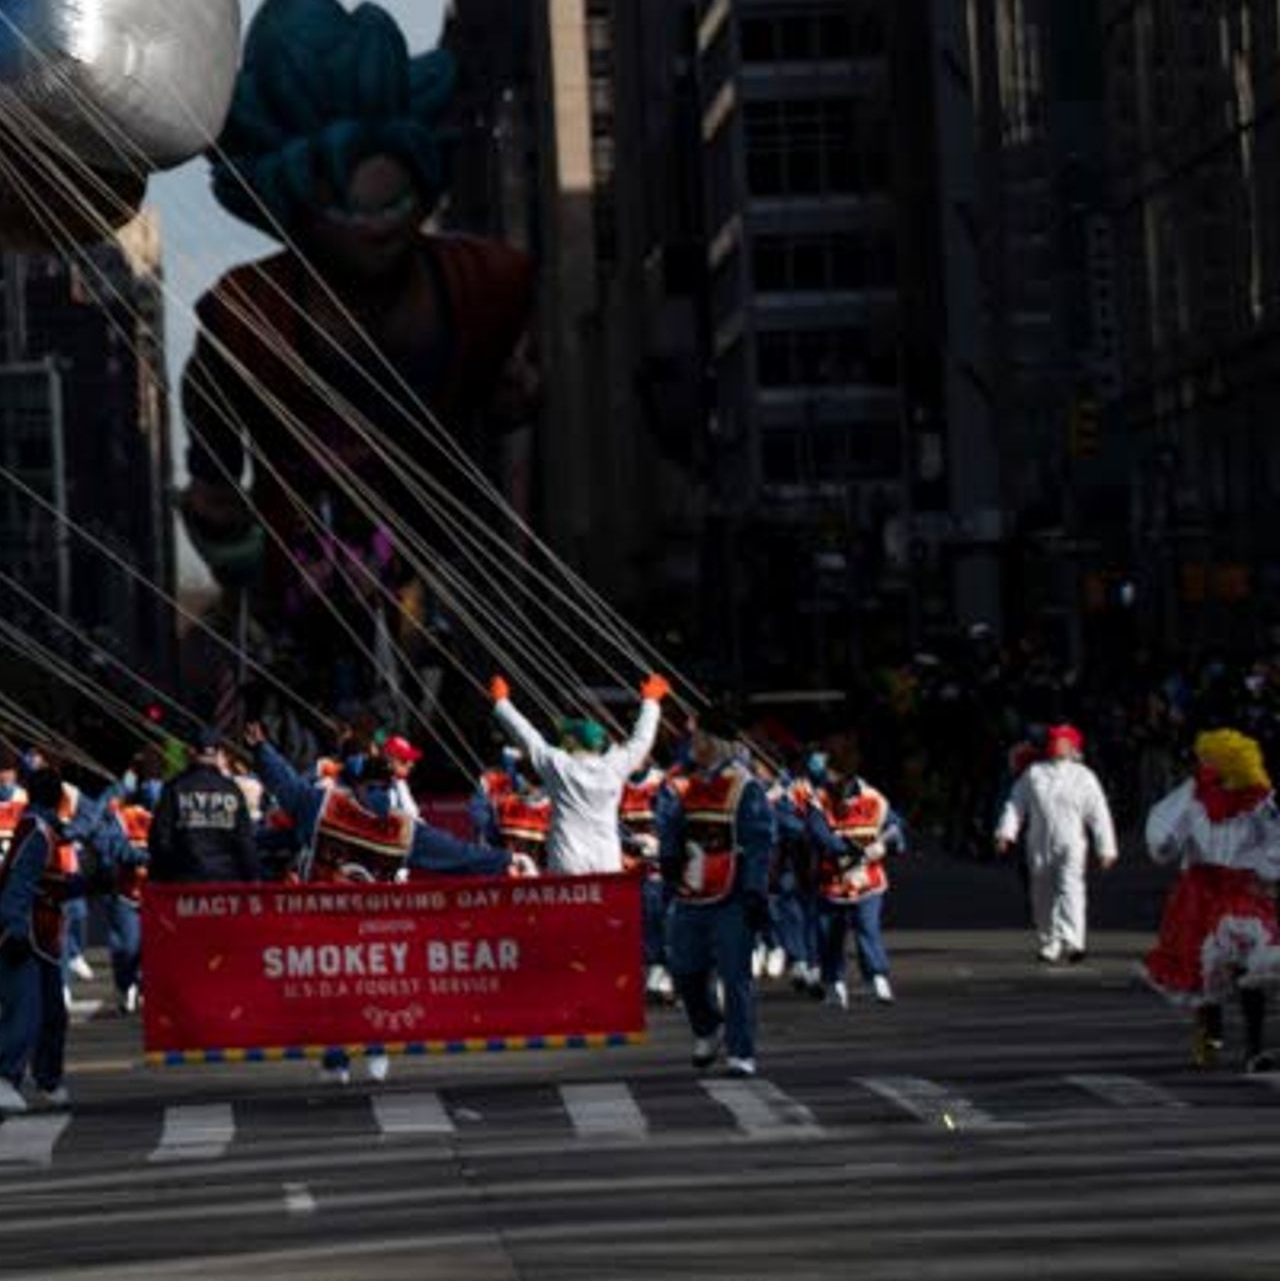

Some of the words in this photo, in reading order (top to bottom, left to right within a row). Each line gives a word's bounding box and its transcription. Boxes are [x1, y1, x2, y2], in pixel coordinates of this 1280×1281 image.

[179, 791, 238, 814] NYPD
[275, 890, 446, 914] THANKSGIVING
[512, 883, 603, 905] PARADE
[263, 941, 408, 978] SMOKEY
[427, 938, 520, 972] BEAR
[430, 976, 500, 995] SERVICE
